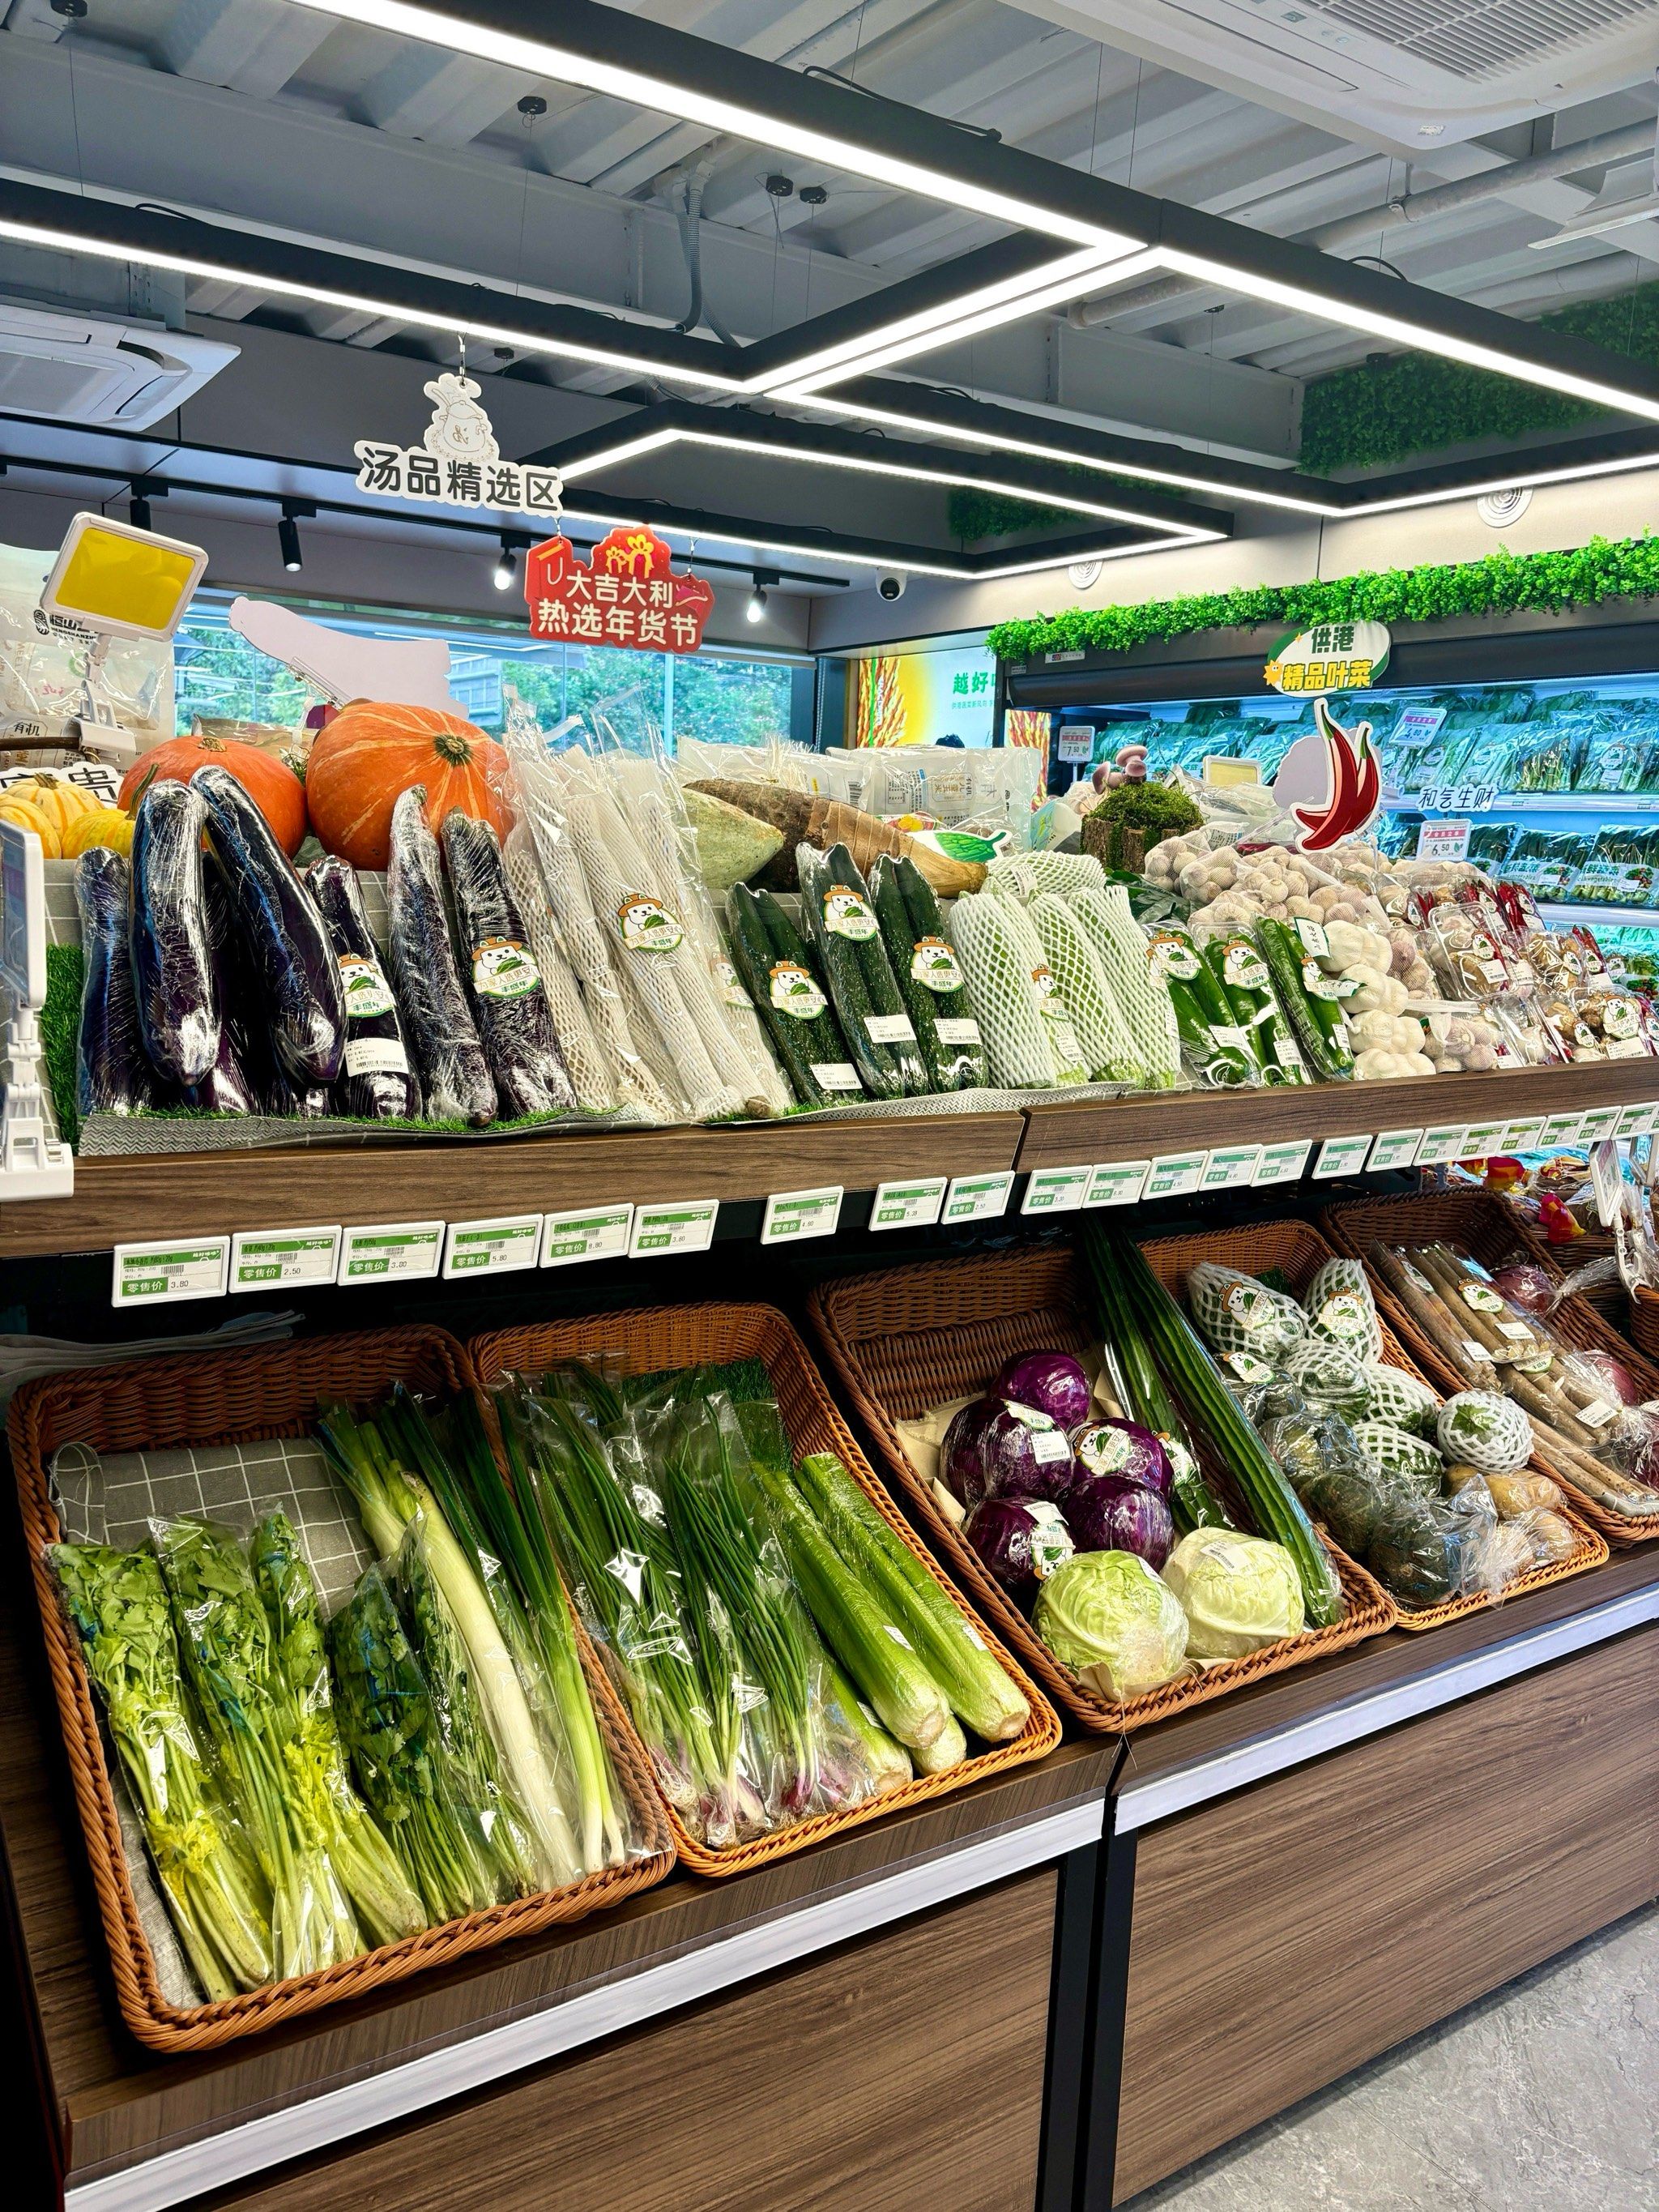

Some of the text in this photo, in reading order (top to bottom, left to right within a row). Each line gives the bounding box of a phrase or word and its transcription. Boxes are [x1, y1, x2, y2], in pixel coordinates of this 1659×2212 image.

[362, 446, 559, 511] 汤品精选区
[566, 570, 673, 609] 大吉大利
[538, 598, 698, 647] 热选年货节
[1311, 625, 1354, 654] 供港
[1282, 659, 1373, 691] 精品叶菜
[14, 721, 40, 737] 有机
[1418, 787, 1495, 809] 和气生财
[881, 1211, 902, 1220] 零售价
[951, 1204, 972, 1214] 零售价
[774, 1222, 798, 1232] 零售价
[555, 1241, 603, 1254] 零售价 8.80
[642, 1236, 667, 1246] 零售价
[456, 1254, 507, 1266] 零售价 5.80
[243, 1267, 301, 1279] 零售价 2.50
[352, 1261, 385, 1273] 零售价
[127, 1279, 189, 1293] 零售价 3.80
